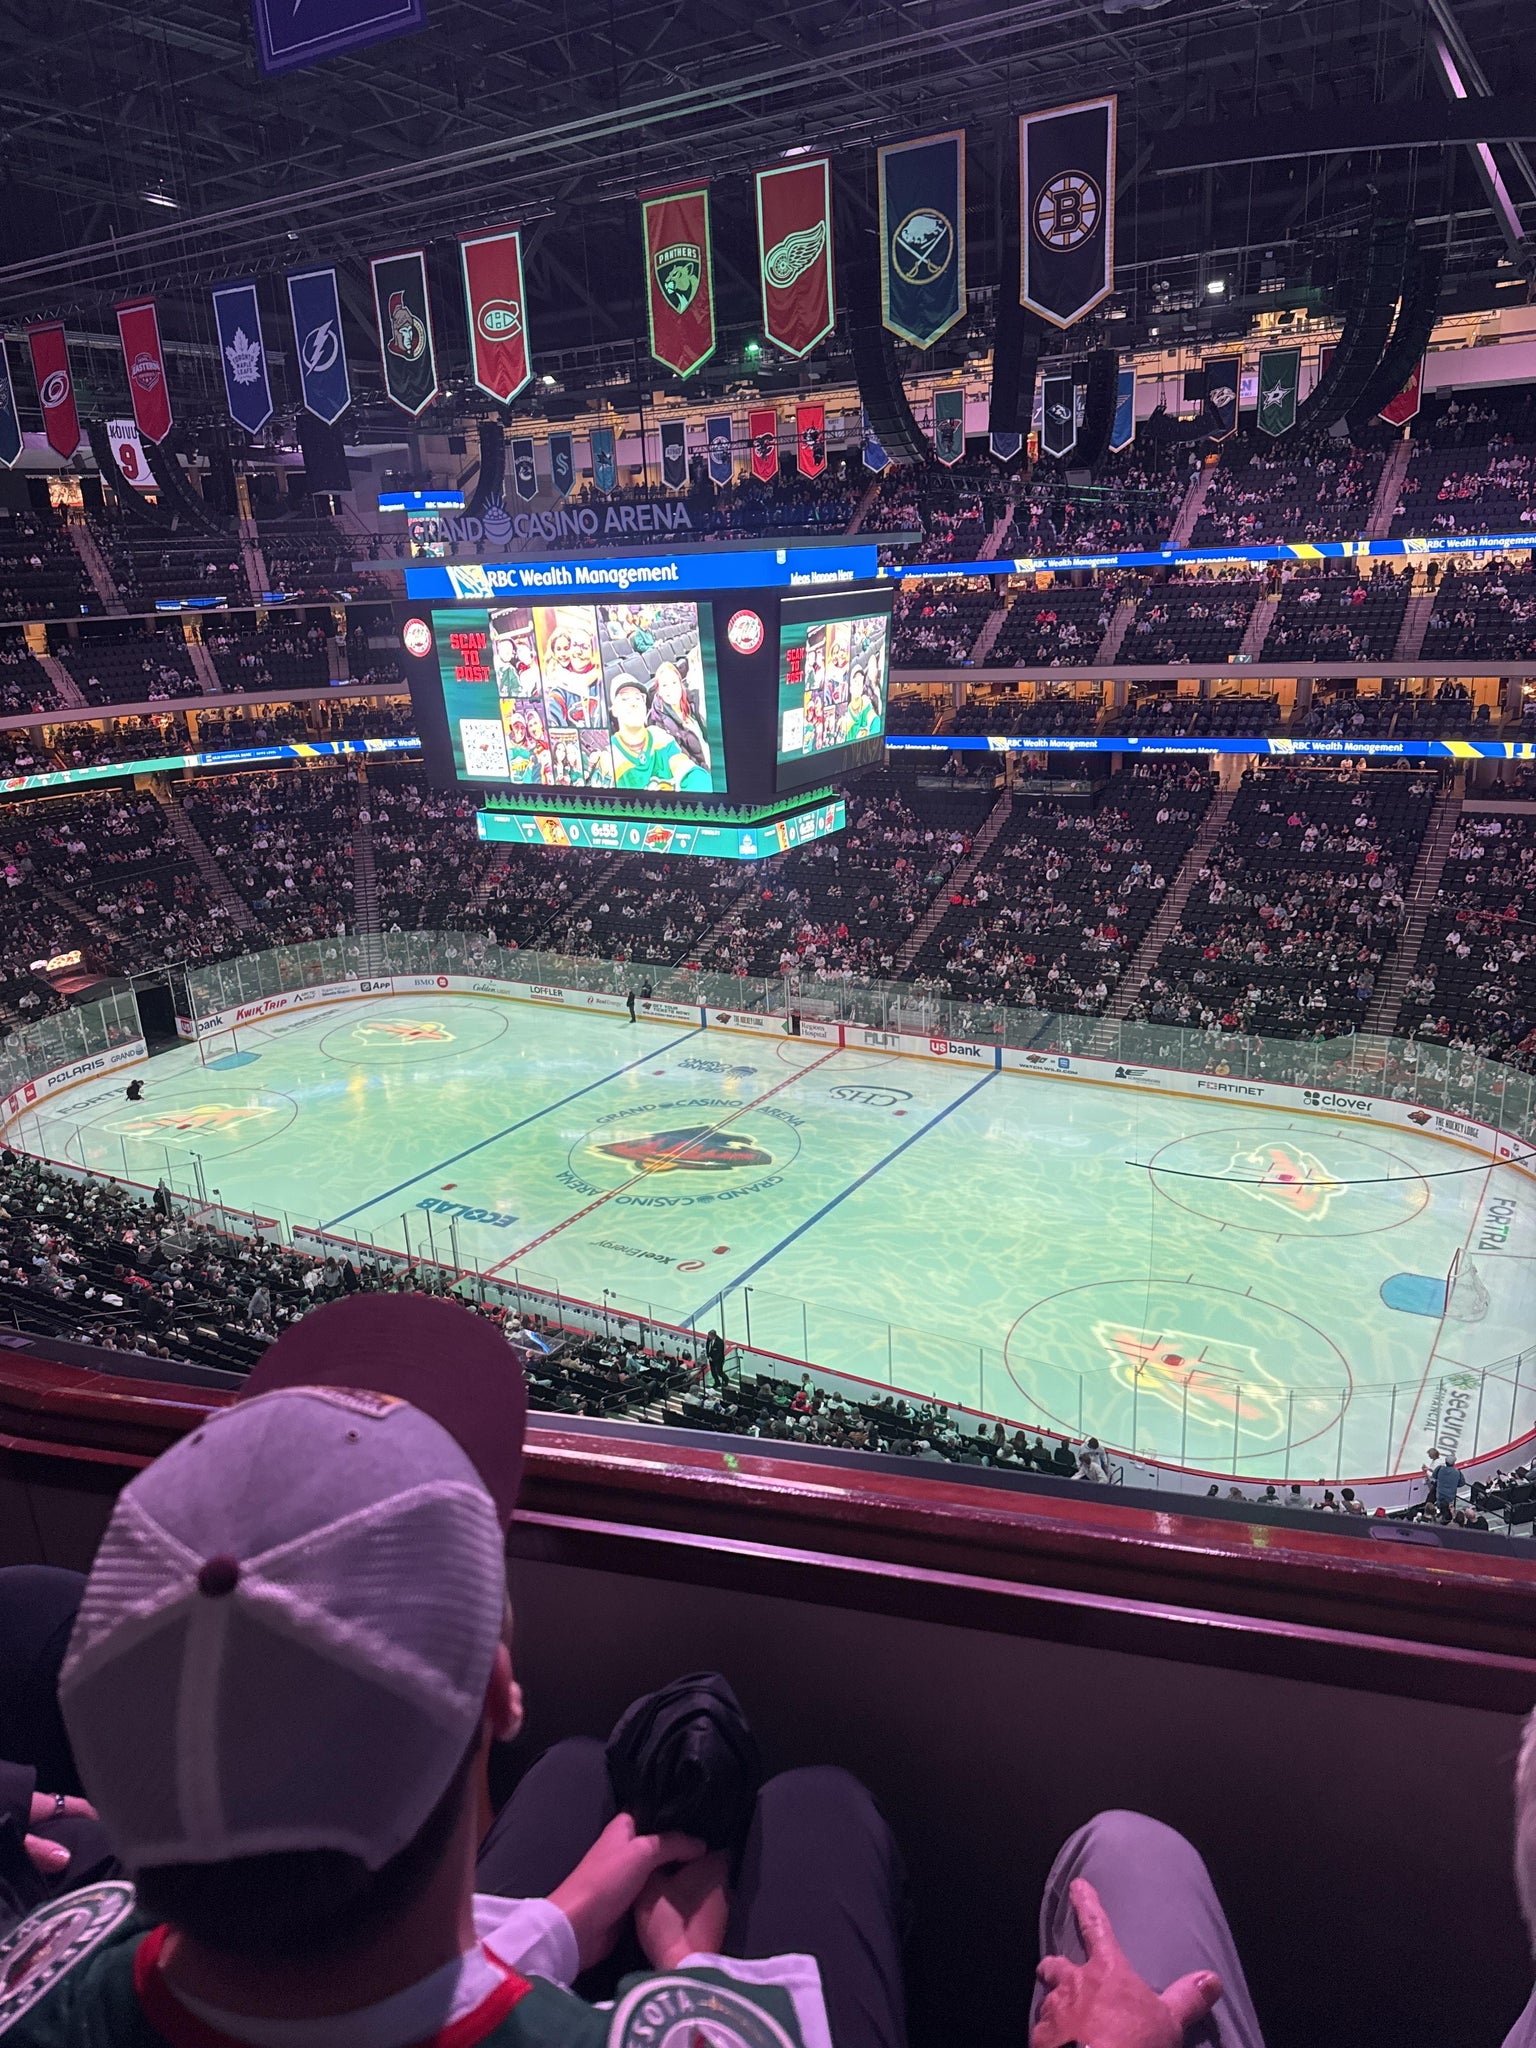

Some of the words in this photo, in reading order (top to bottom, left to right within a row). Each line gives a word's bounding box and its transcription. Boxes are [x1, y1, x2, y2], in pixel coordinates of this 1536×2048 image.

[1052, 187, 1083, 235] B
[658, 247, 697, 264] PANTHERS
[233, 353, 255, 363] TORONTO
[118, 444, 139, 480] 9
[408, 516, 484, 543] GRAND
[514, 508, 599, 541] CASINO
[603, 501, 693, 533] ARENA
[1428, 540, 1445, 548] RBC
[1447, 538, 1478, 547] Wealth
[1048, 558, 1072, 567] Wealth
[1073, 556, 1118, 568] Management
[487, 570, 518, 588] RBC
[521, 566, 573, 586] Wealth
[575, 562, 679, 589] Management
[449, 632, 487, 650] SCAN
[461, 650, 480, 666] TO
[785, 647, 805, 661] SCAN
[455, 666, 491, 682] POST
[790, 660, 800, 672] TO
[785, 671, 804, 685] POST
[1023, 739, 1048, 747] Wealth
[1049, 740, 1098, 751] Management
[1292, 742, 1310, 750] RBC
[1312, 741, 1342, 751] Wealth
[1344, 742, 1403, 755] Management
[569, 824, 580, 840] 0
[629, 828, 640, 845] 0
[472, 982, 496, 992] Golden
[530, 985, 564, 997] LOFFLER
[236, 1005, 263, 1021] KWIK
[263, 998, 288, 1013] TRIP
[801, 1022, 825, 1032] Regions
[801, 1029, 827, 1038] Hospital
[111, 1049, 136, 1063] GRAND
[931, 1042, 945, 1052] us
[949, 1042, 981, 1057] bank
[48, 1058, 105, 1087] POLARIS
[1198, 1080, 1265, 1097] FORTINET
[1321, 1094, 1373, 1112] clover
[596, 1104, 657, 1125] GRAND
[675, 1098, 743, 1108] CASINO
[757, 1105, 806, 1128] ARENA
[1435, 1116, 1445, 1127] THE
[1445, 1118, 1464, 1133] HOCKEY
[1464, 1122, 1480, 1139] LODGE
[555, 1170, 605, 1197] ARENA
[717, 1176, 784, 1201] GRAND
[615, 1195, 695, 1208] CASINO
[416, 1197, 520, 1228] ECOLAB
[1478, 1197, 1517, 1251] FORTRA
[627, 1989, 696, 2048] SOTA
